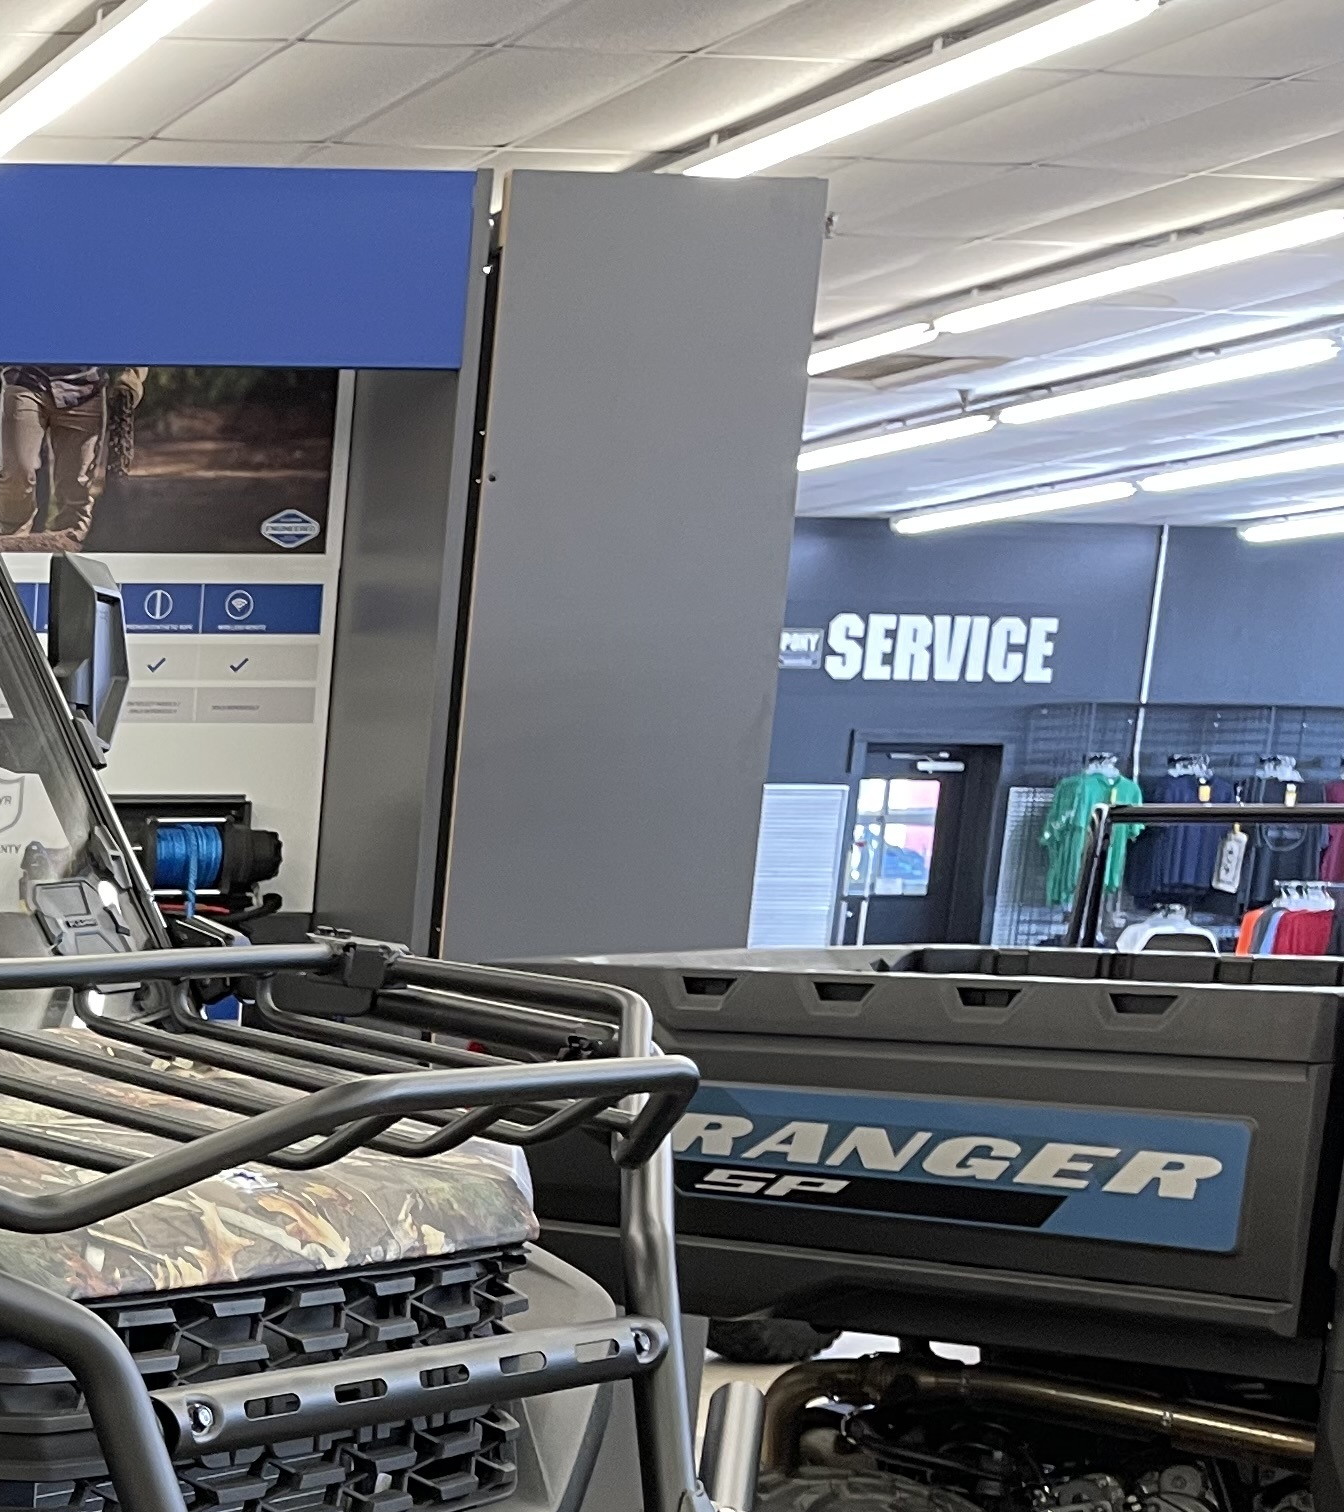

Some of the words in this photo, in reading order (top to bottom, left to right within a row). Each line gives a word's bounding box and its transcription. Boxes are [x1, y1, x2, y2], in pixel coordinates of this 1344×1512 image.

[824, 612, 1060, 684] SERVICE
[670, 1111, 1224, 1201] RANGER
[694, 1169, 853, 1198] SP
